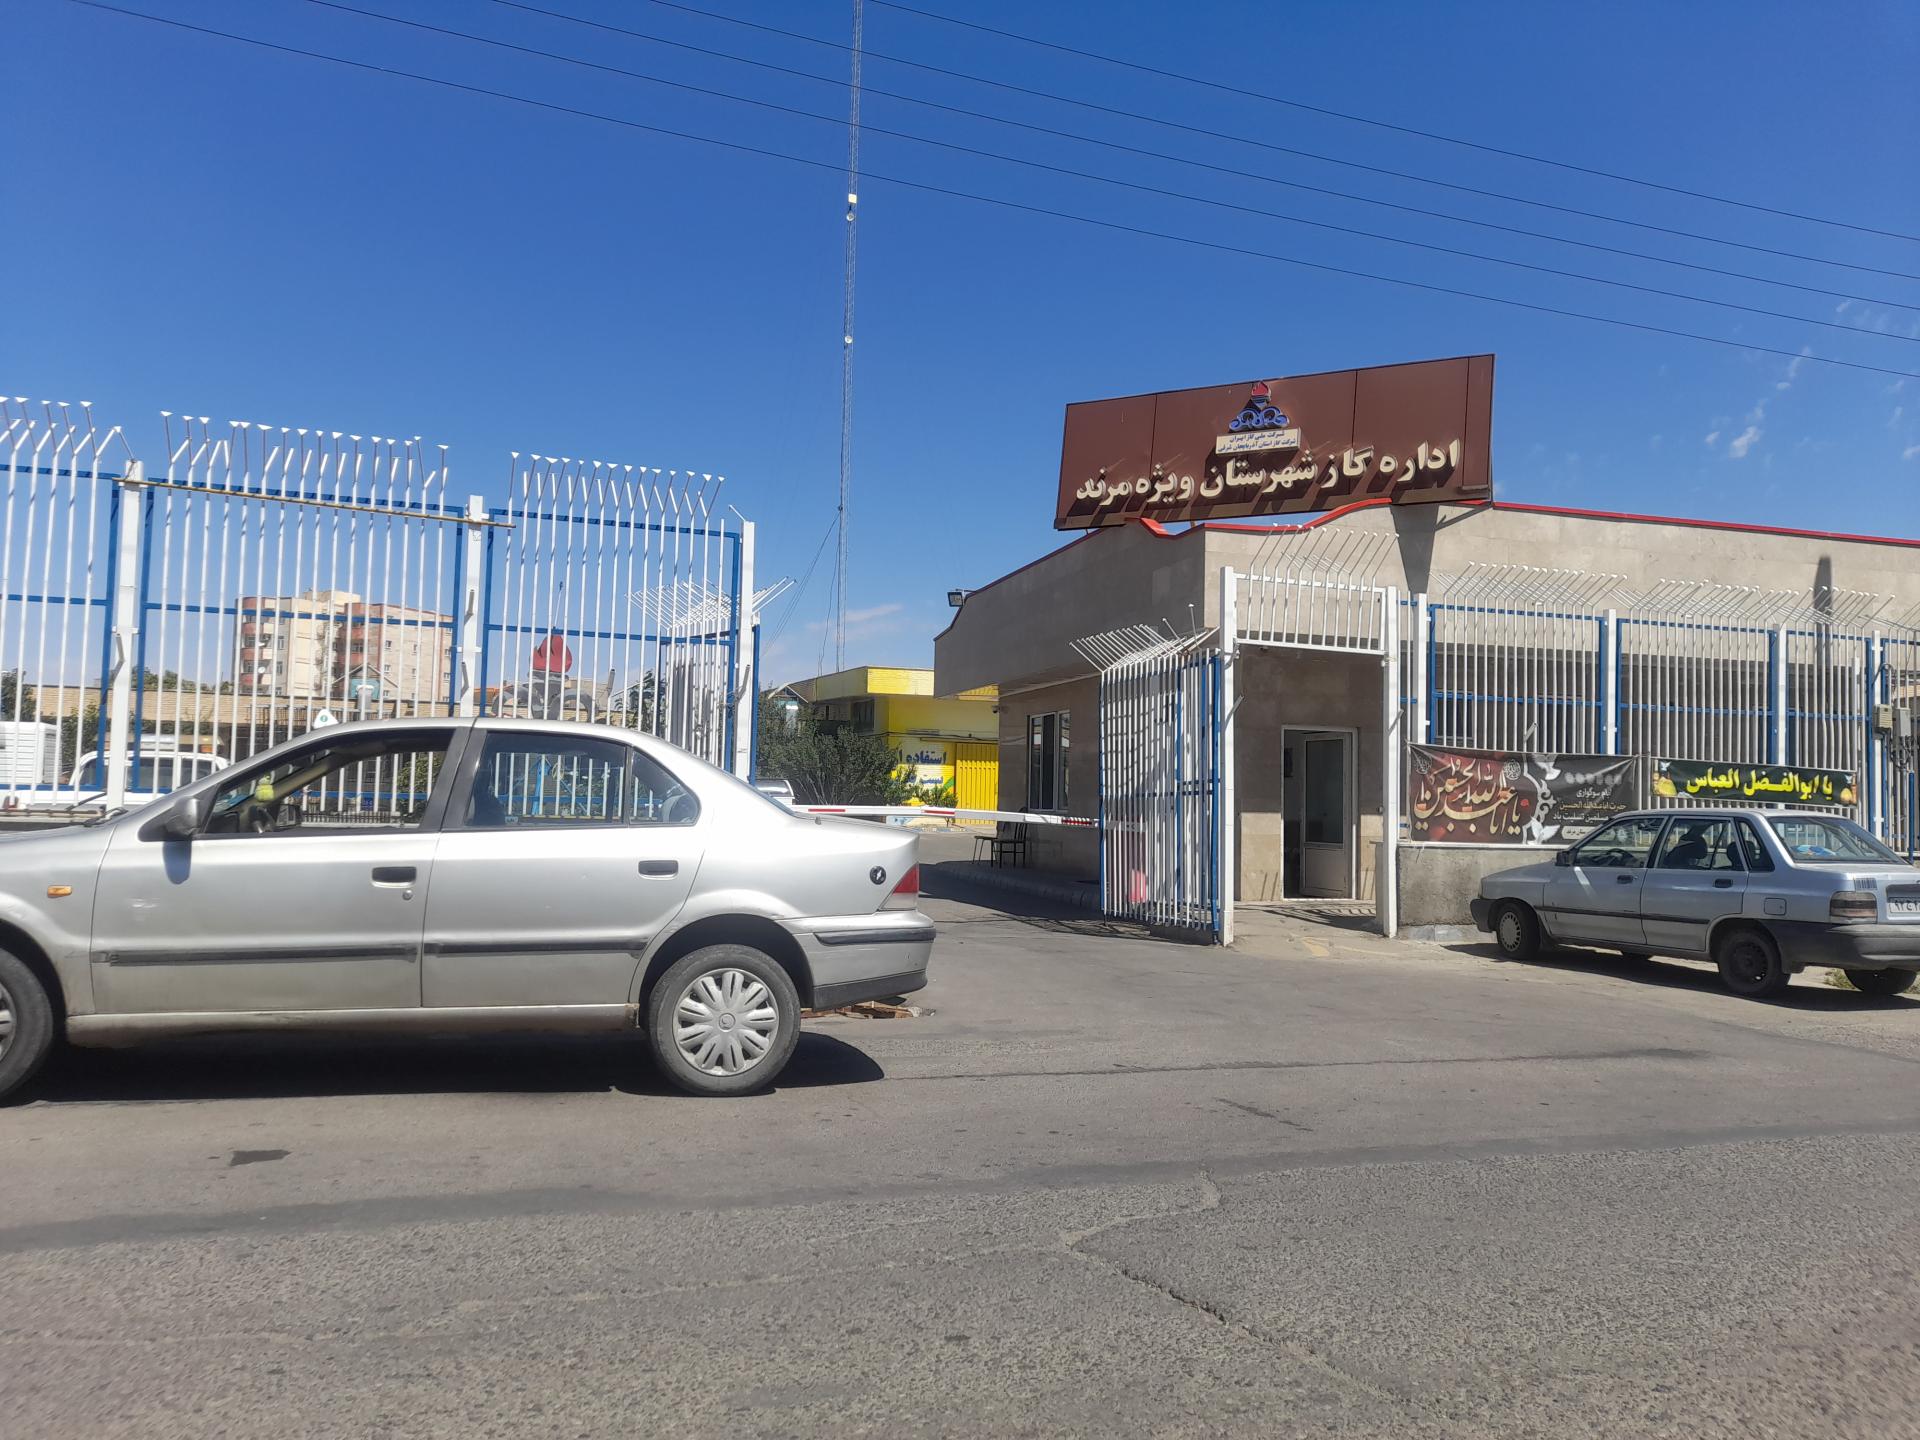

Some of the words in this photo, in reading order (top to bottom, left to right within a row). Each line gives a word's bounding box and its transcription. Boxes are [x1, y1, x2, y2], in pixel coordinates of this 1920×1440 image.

[1200, 449, 1318, 497] شهرستان
[1321, 446, 1374, 488] گاز
[1379, 439, 1460, 482] اداره
[1076, 469, 1132, 506] مرند
[1135, 464, 1195, 503] ویژه
[1686, 767, 1740, 793] العباس
[1822, 775, 1833, 800] یا
